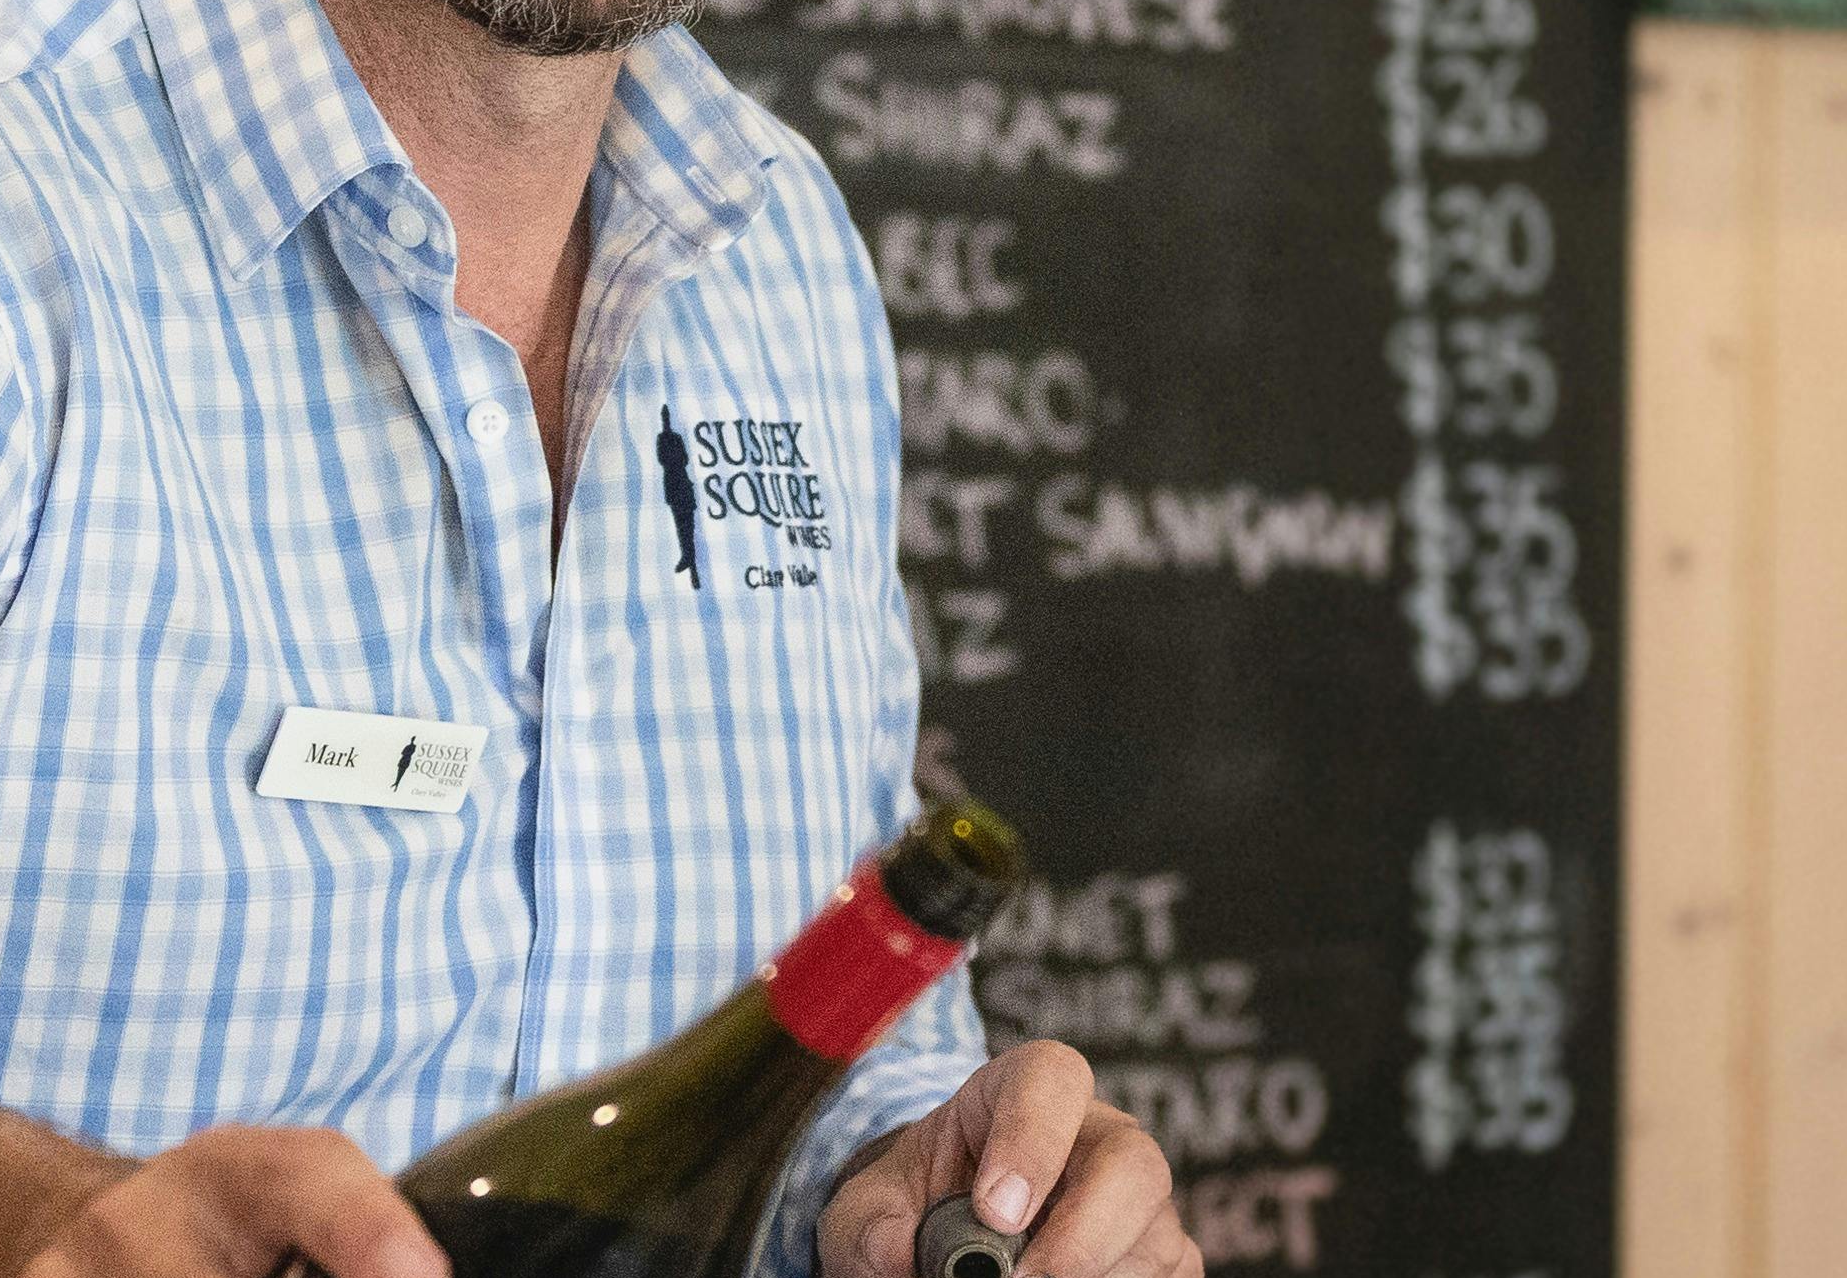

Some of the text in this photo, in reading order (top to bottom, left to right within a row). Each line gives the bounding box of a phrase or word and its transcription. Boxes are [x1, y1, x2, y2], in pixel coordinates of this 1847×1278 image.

[704, 471, 825, 527] SQUIRE
[305, 743, 472, 768] Mark SUSSEX
[412, 759, 468, 779] SQUIRE
